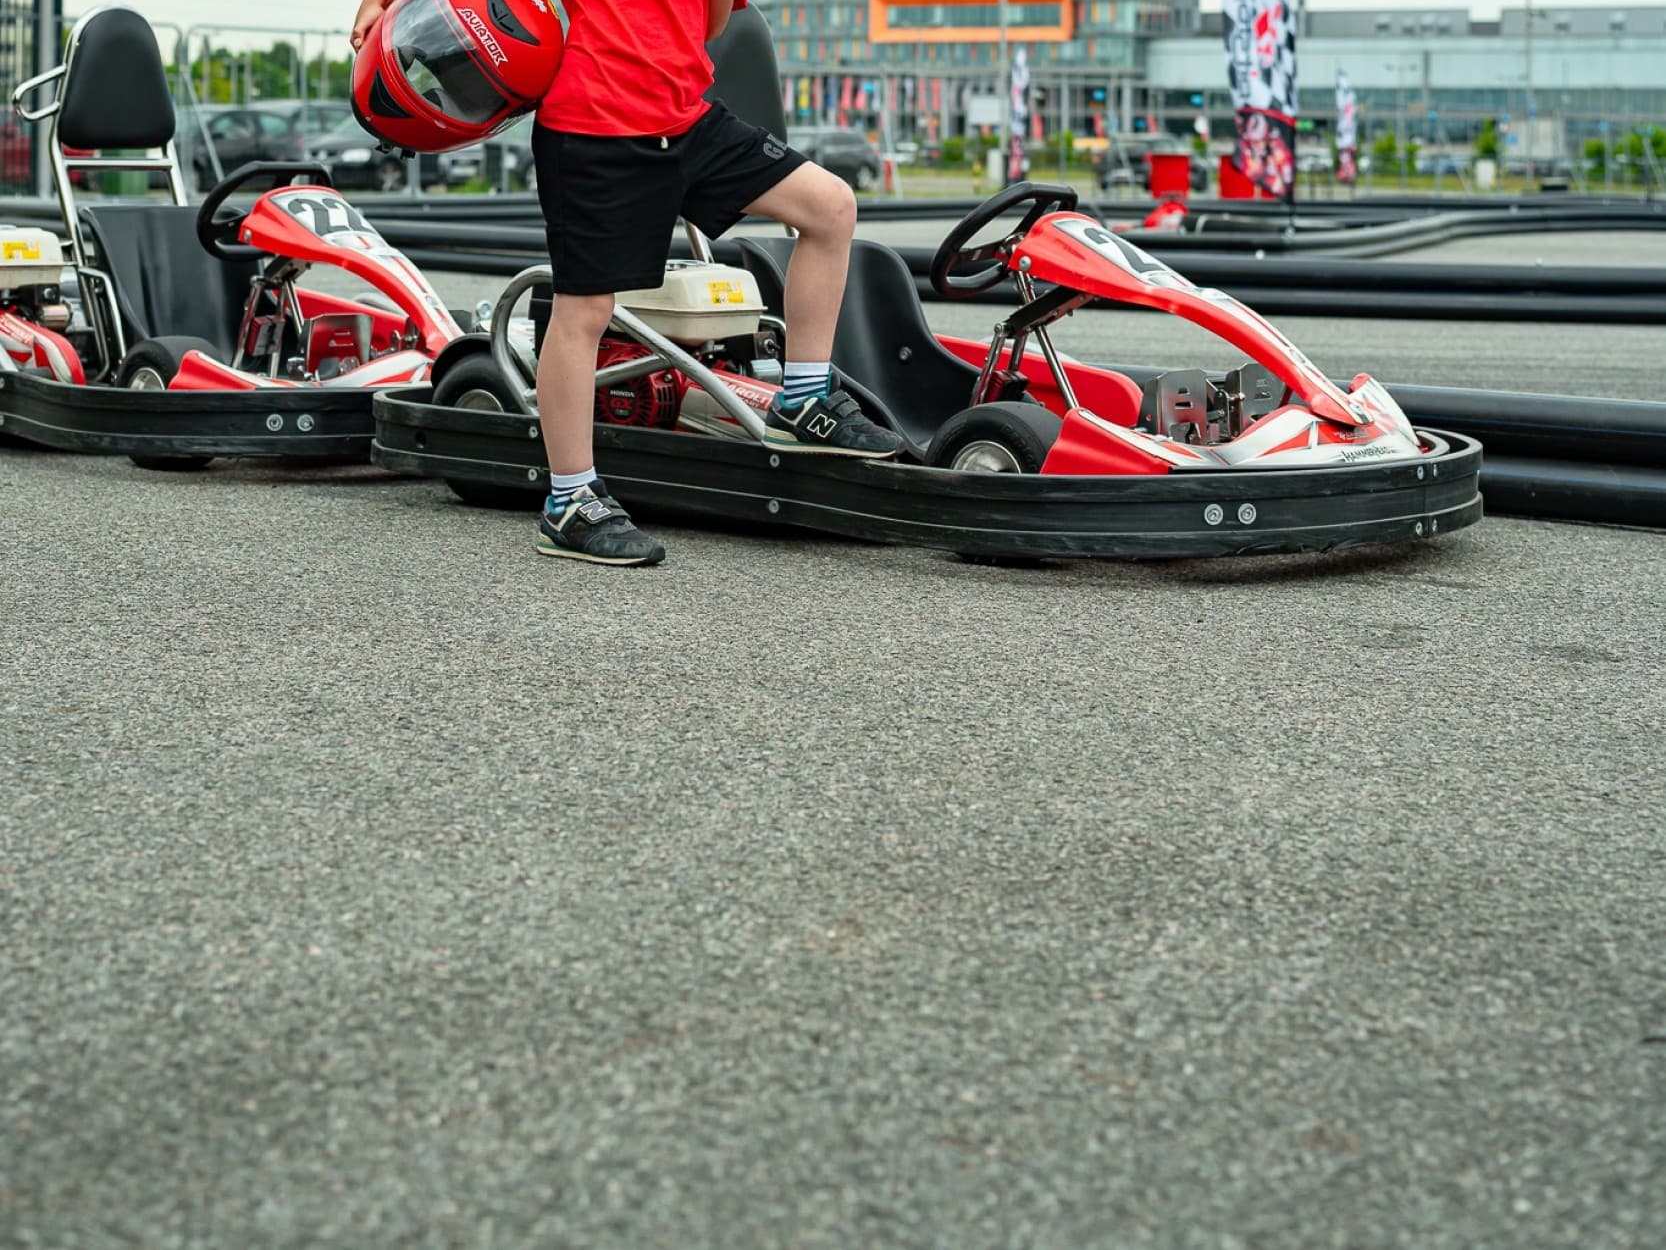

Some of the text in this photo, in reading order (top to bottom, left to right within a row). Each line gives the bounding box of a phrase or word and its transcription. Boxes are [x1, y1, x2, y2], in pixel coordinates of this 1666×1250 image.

[458, 8, 507, 65] AVIATOR
[287, 197, 377, 237] 22
[609, 389, 636, 398] HONDA
[806, 413, 837, 438] N
[578, 500, 612, 521] N
